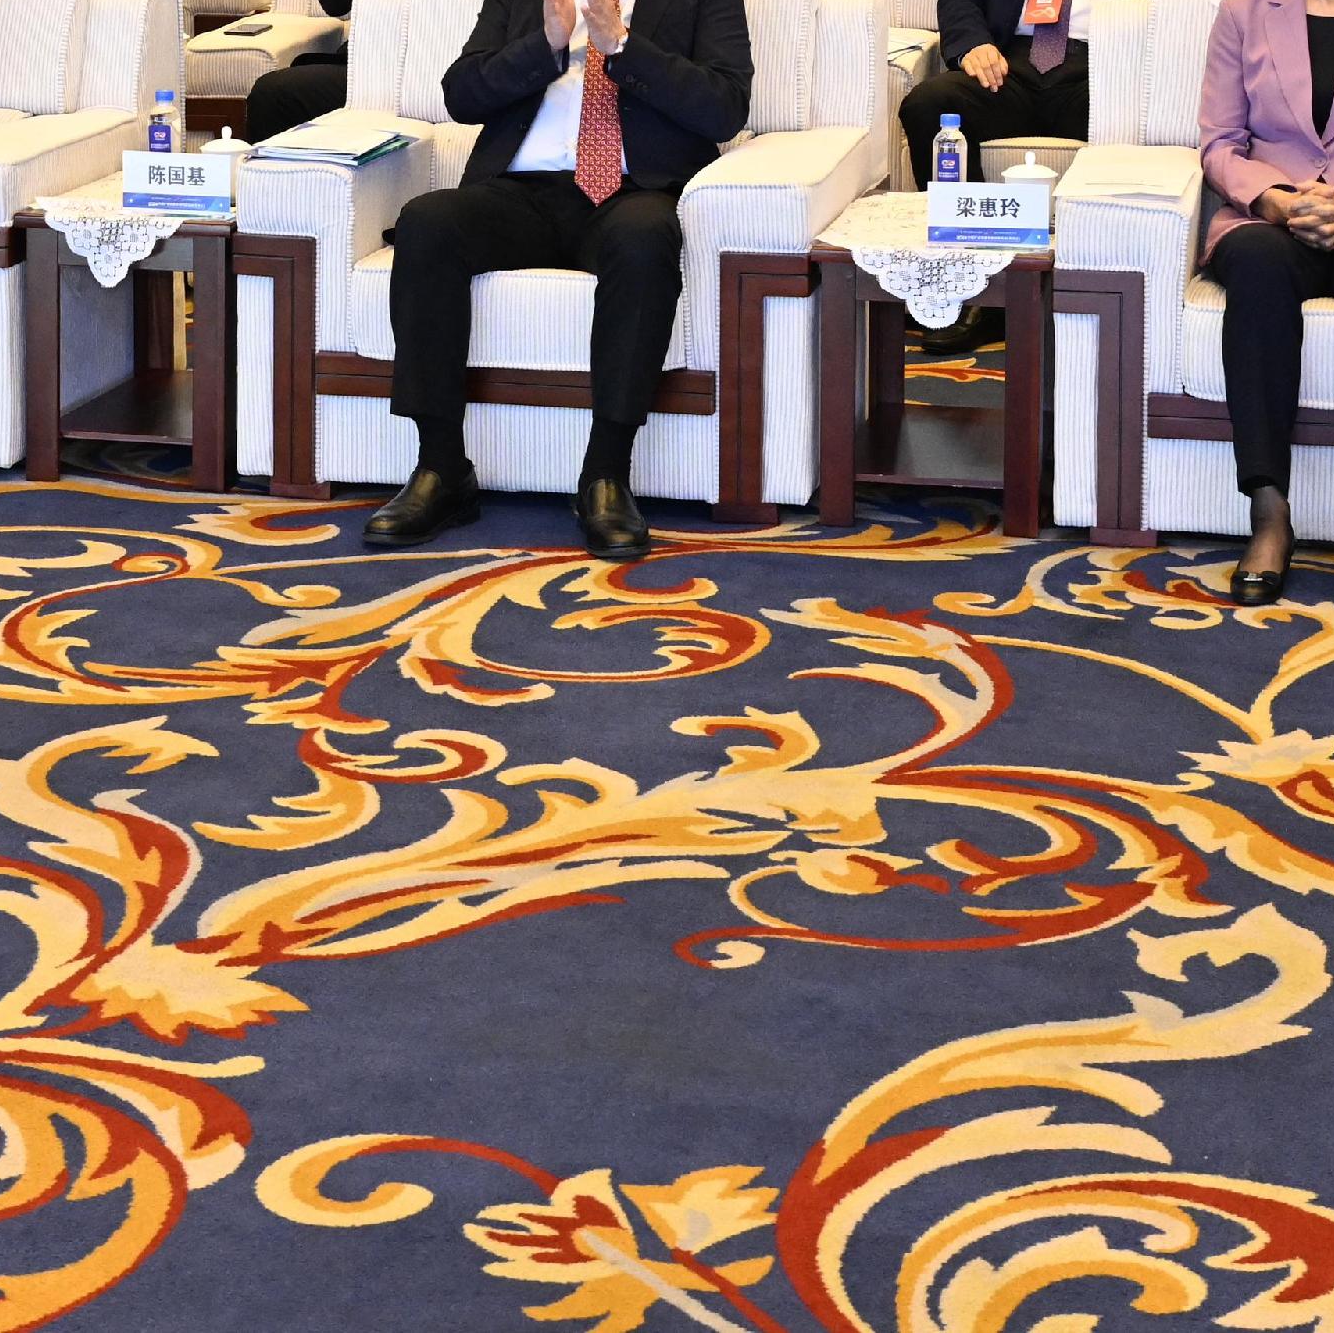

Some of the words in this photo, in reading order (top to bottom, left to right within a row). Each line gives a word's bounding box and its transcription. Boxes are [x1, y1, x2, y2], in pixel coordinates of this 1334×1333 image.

[148, 165, 206, 186] 陈国基
[956, 196, 1021, 218] 梁惠玲
